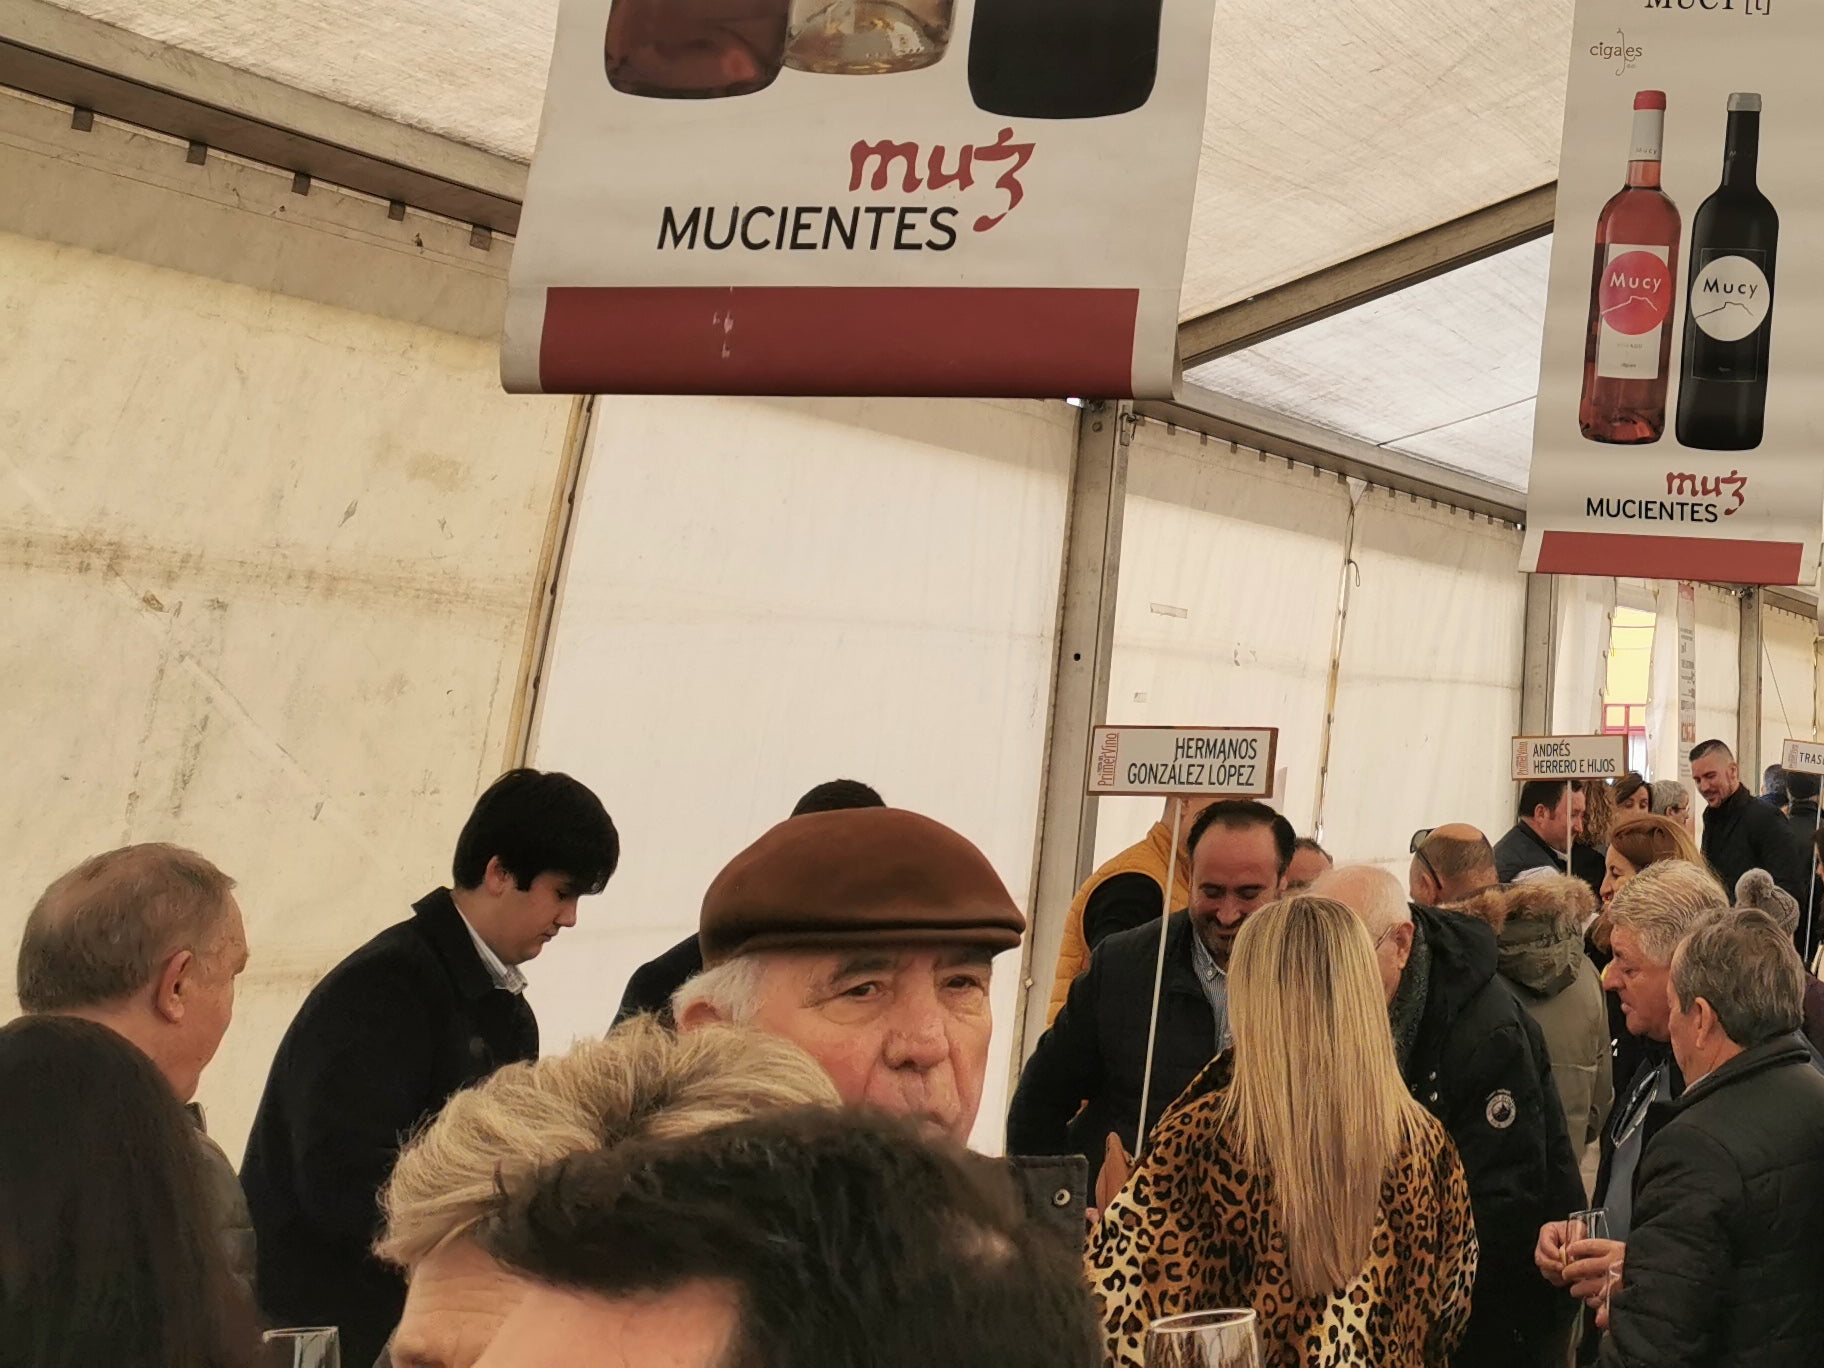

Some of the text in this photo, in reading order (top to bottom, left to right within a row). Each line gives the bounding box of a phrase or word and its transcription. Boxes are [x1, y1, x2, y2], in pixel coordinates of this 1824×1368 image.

[656, 205, 957, 252] MUCIENTES
[1610, 272, 1662, 294] Mucy
[1703, 277, 1759, 297] Mucy
[1586, 497, 1719, 522] MUCIENTES
[1175, 737, 1258, 760] HERMANOS
[1532, 739, 1571, 758] ANDRÉS
[1127, 758, 1205, 785] GONZÁLEZ
[1208, 759, 1256, 786] LÓPEZ
[1533, 758, 1616, 774] HERRERO E HIJOS
